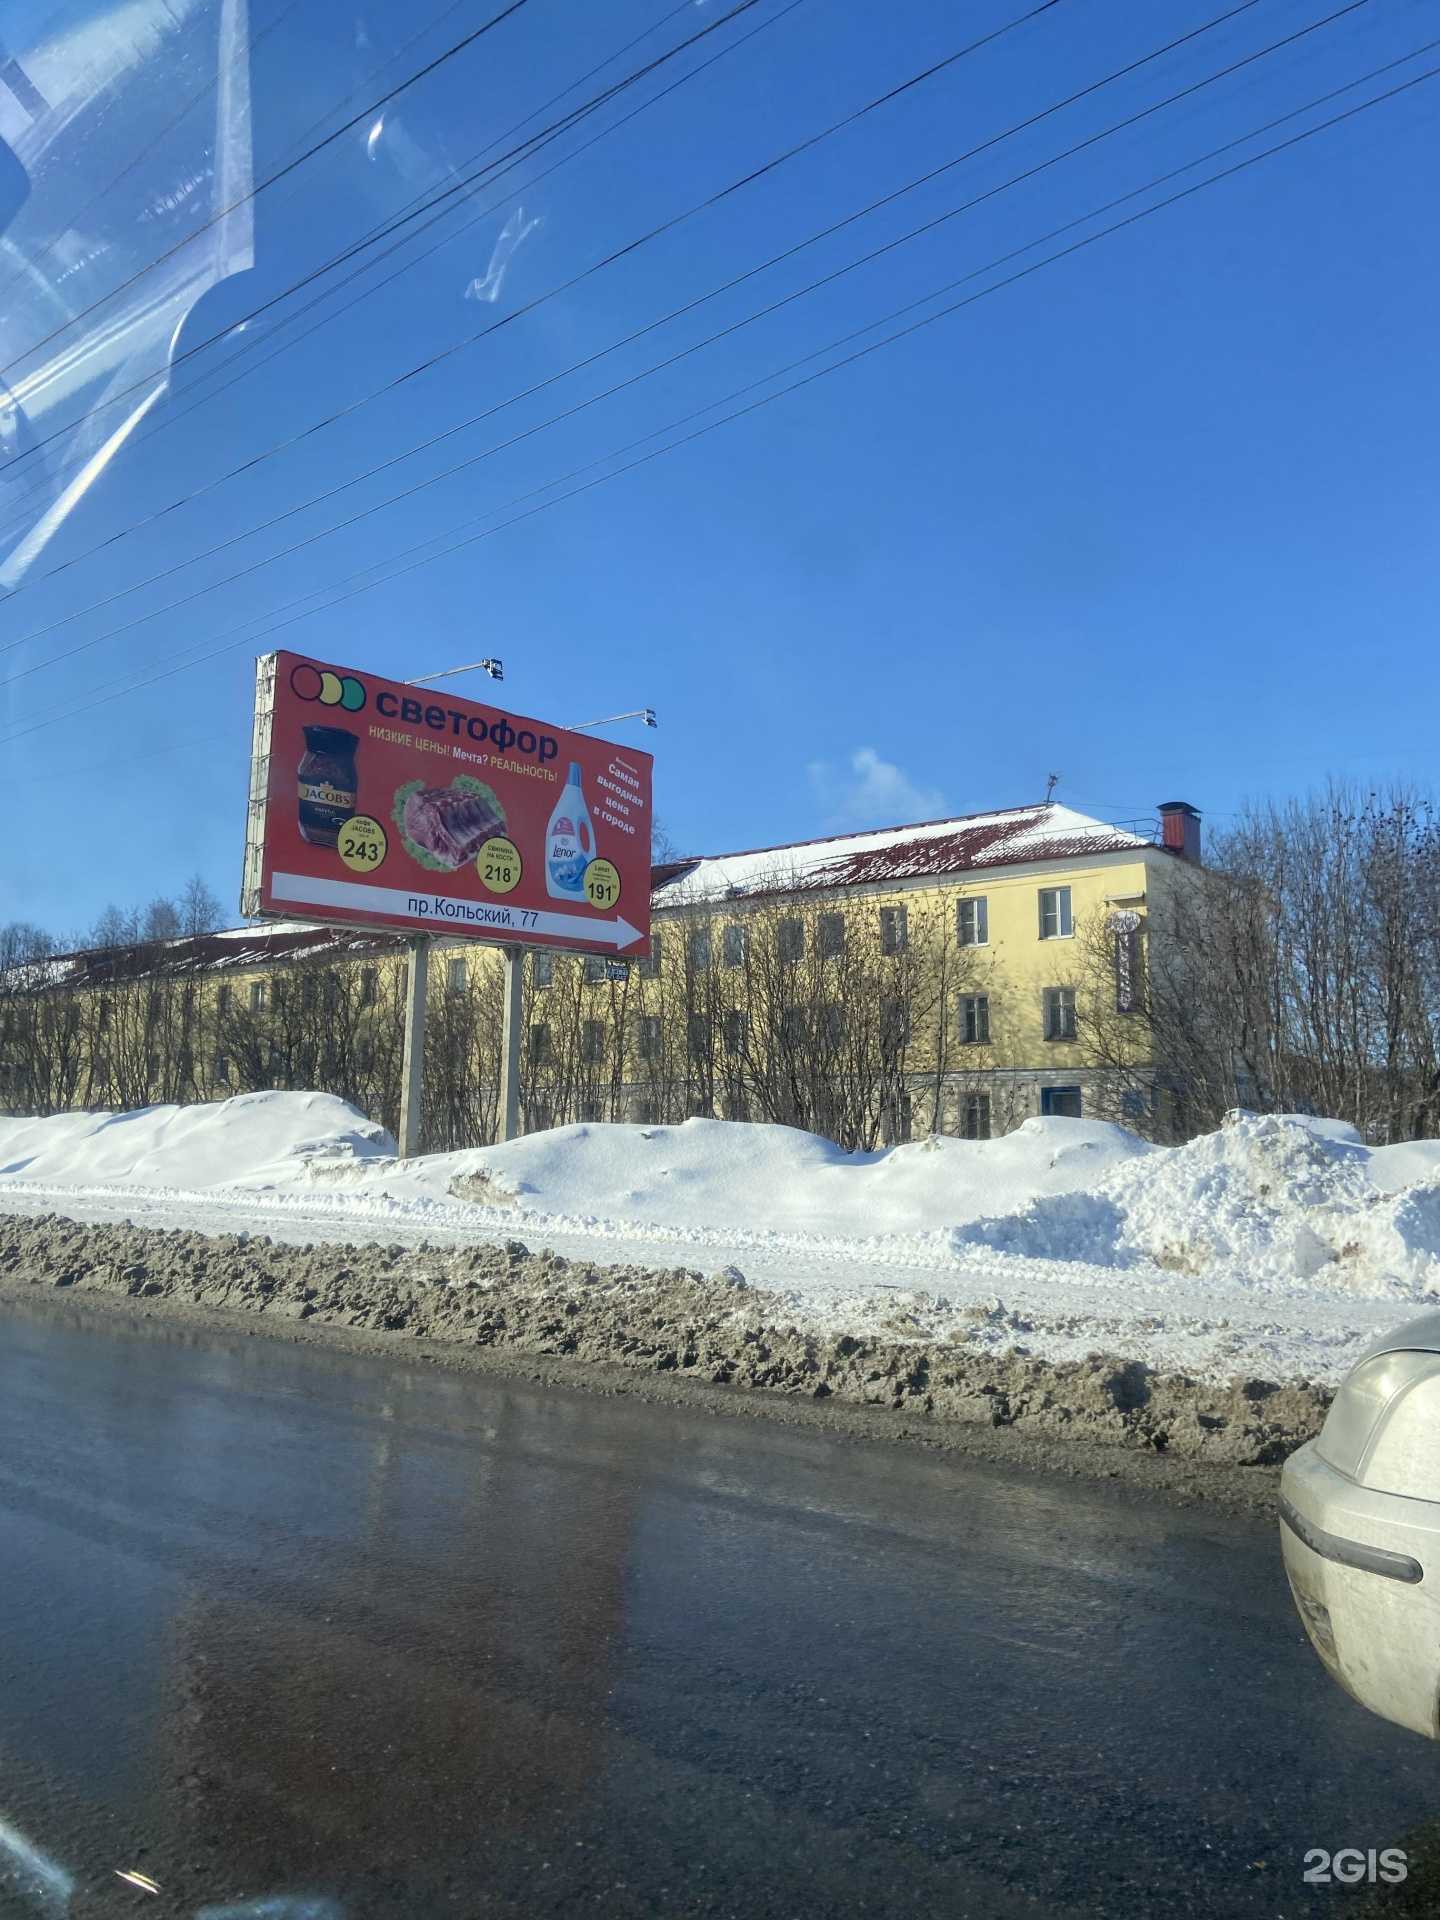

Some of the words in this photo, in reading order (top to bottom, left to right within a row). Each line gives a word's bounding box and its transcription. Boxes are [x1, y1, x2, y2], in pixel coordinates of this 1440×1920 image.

[376, 692, 558, 762] светофор
[369, 726, 412, 746] НИЗКИЕ
[415, 738, 450, 756] ЦЕНЫ!
[452, 746, 488, 765] Мечта?
[490, 756, 558, 783] РЕАЛЬНОСТЬ!
[608, 763, 640, 789] Самая
[303, 788, 352, 805] JACOBS
[597, 775, 644, 807] выгодная
[605, 796, 629, 815] цена
[593, 806, 600, 815] в
[601, 811, 636, 834] городе
[343, 838, 378, 861] 243
[552, 843, 577, 858] Lenor
[485, 864, 512, 883] 218
[588, 882, 612, 901] 191
[521, 910, 539, 928] 77
